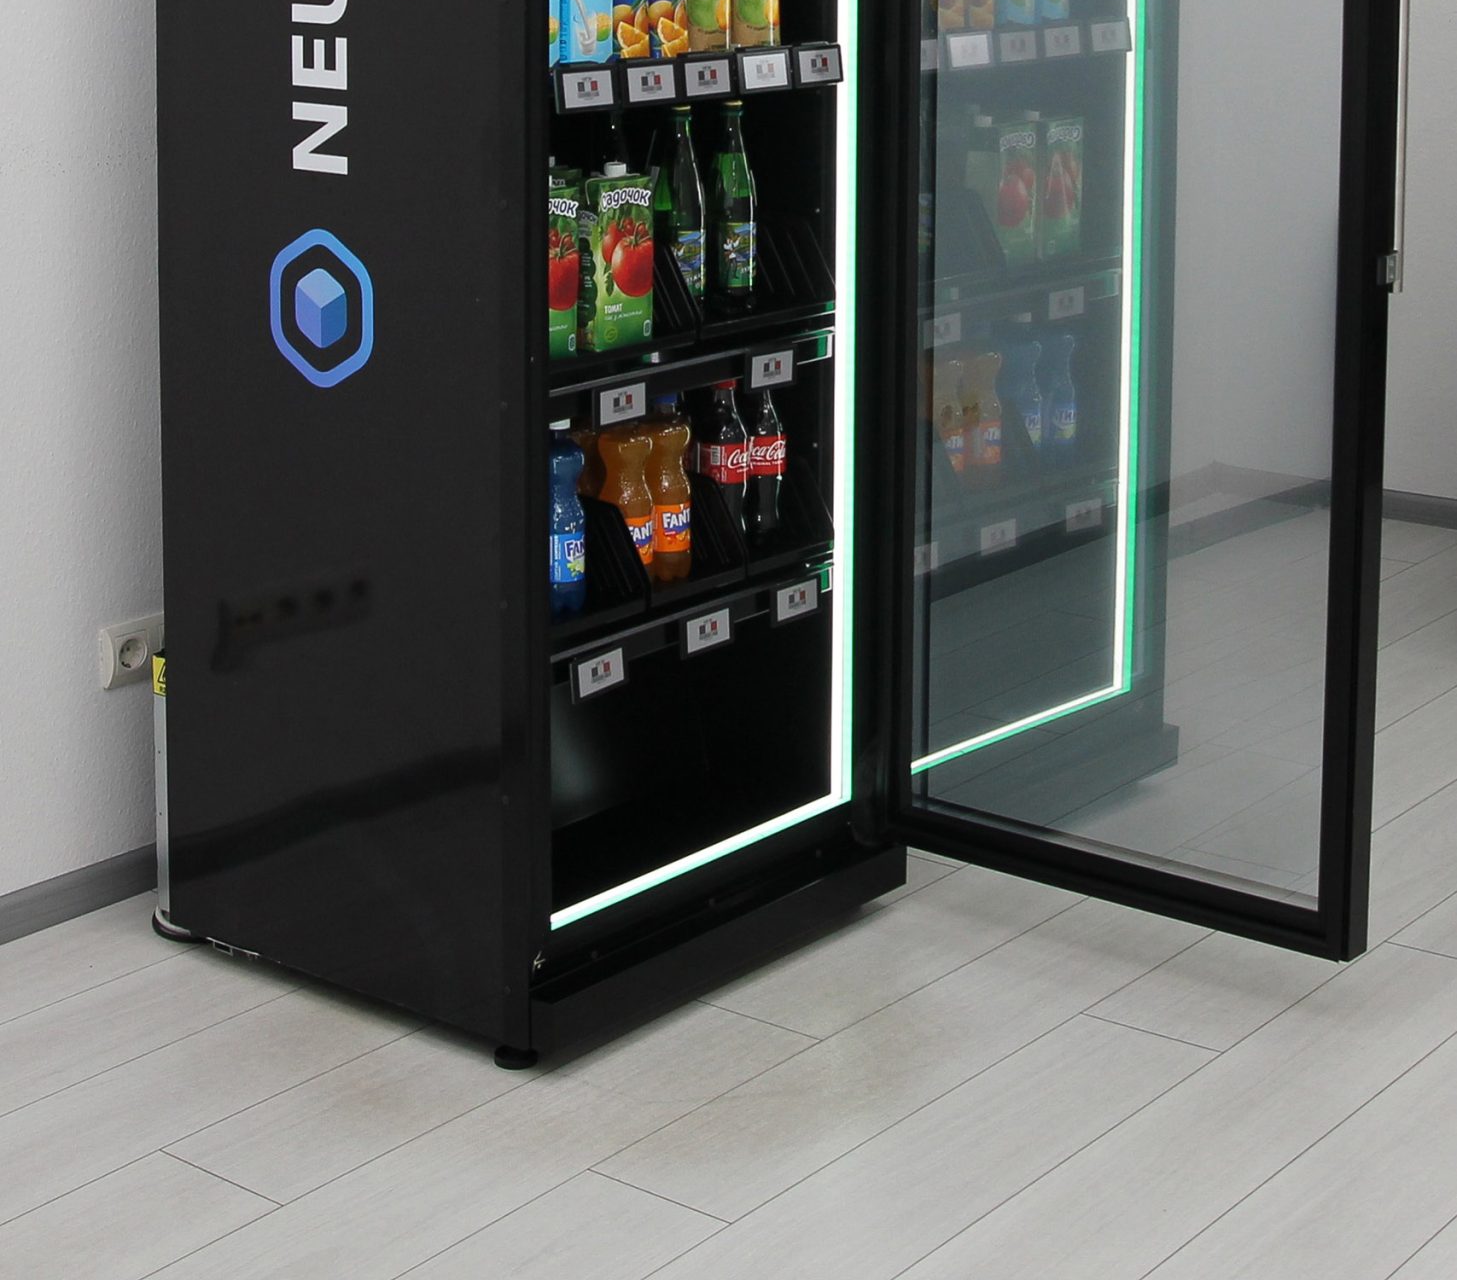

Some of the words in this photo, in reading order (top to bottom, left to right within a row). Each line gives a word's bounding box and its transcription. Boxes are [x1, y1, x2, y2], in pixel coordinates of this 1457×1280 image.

[663, 508, 691, 529] FANT
[628, 521, 653, 543] FANT
[565, 540, 585, 558] FAN
